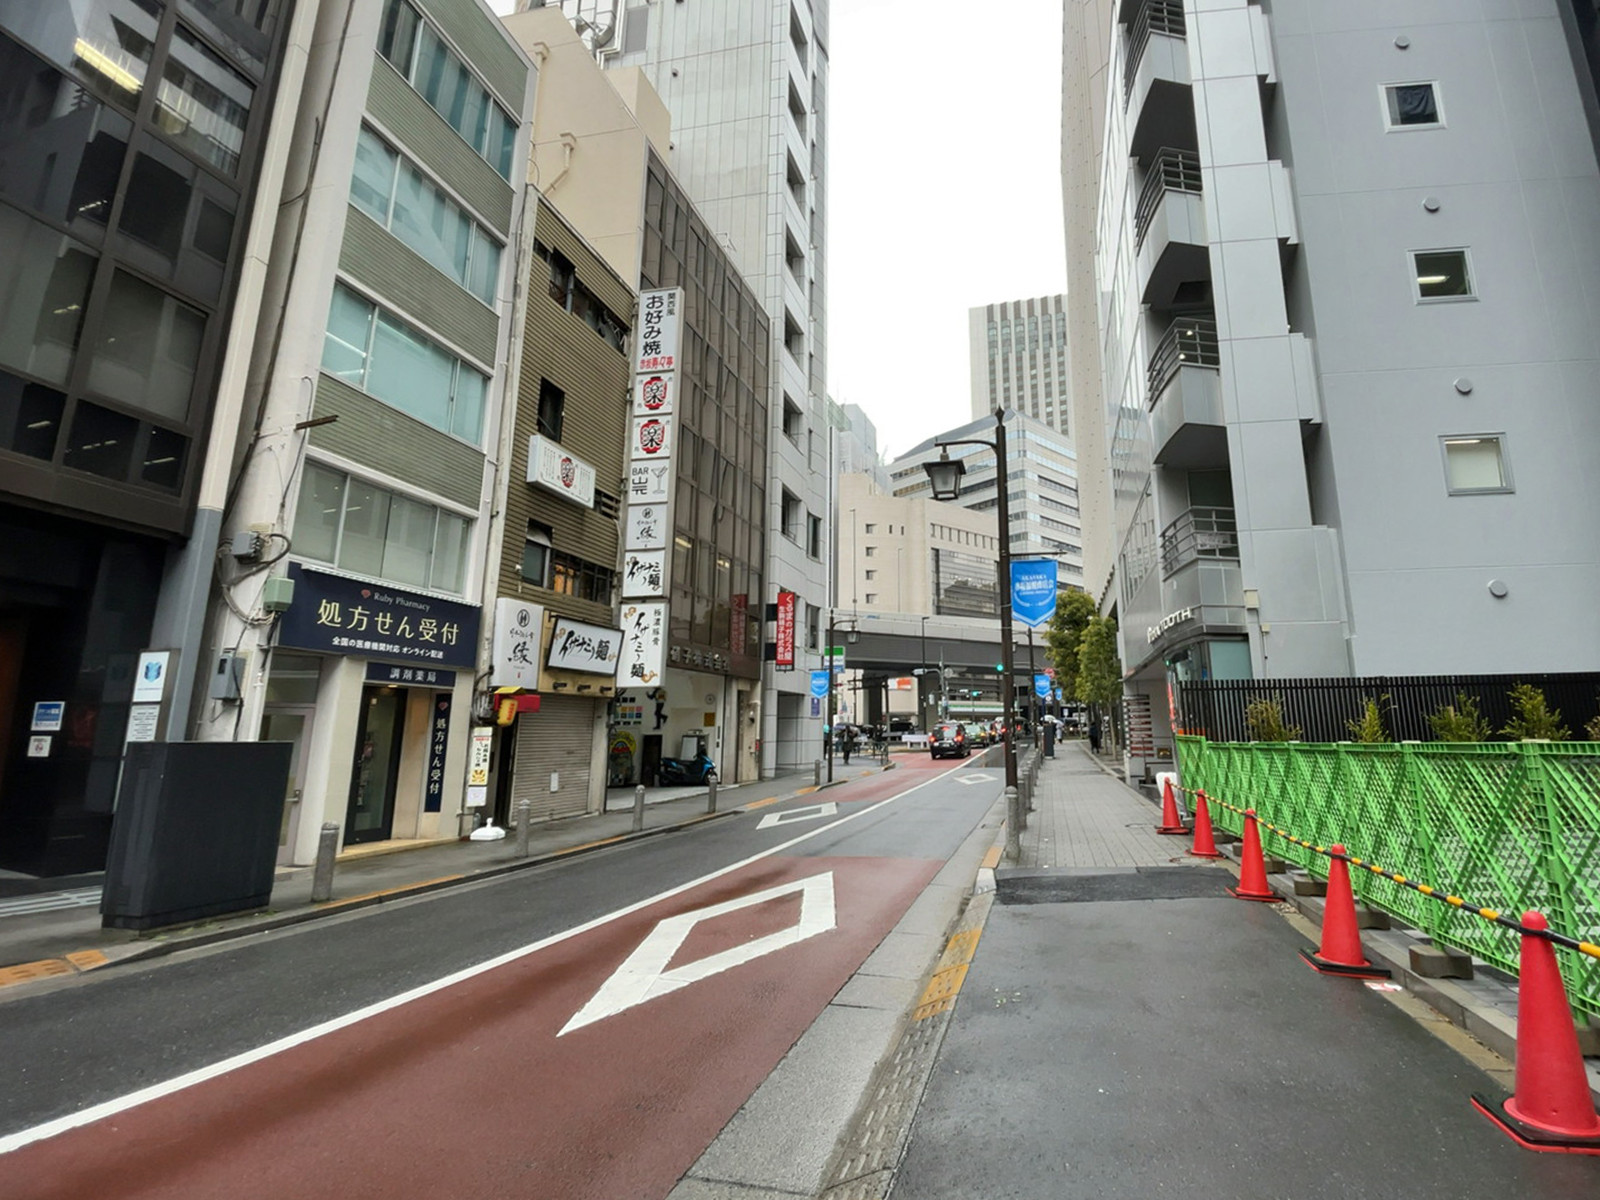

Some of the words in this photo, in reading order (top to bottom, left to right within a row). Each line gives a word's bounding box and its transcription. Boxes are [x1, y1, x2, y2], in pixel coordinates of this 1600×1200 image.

[642, 295, 664, 357] お好み焼
[631, 467, 649, 476] BAR
[374, 592, 394, 605] Ruby
[395, 597, 431, 613] Pharmacy
[317, 599, 460, 646] 処方せん受付
[389, 667, 437, 683] 調剤薬局
[430, 718, 446, 794] 処方せん受付
